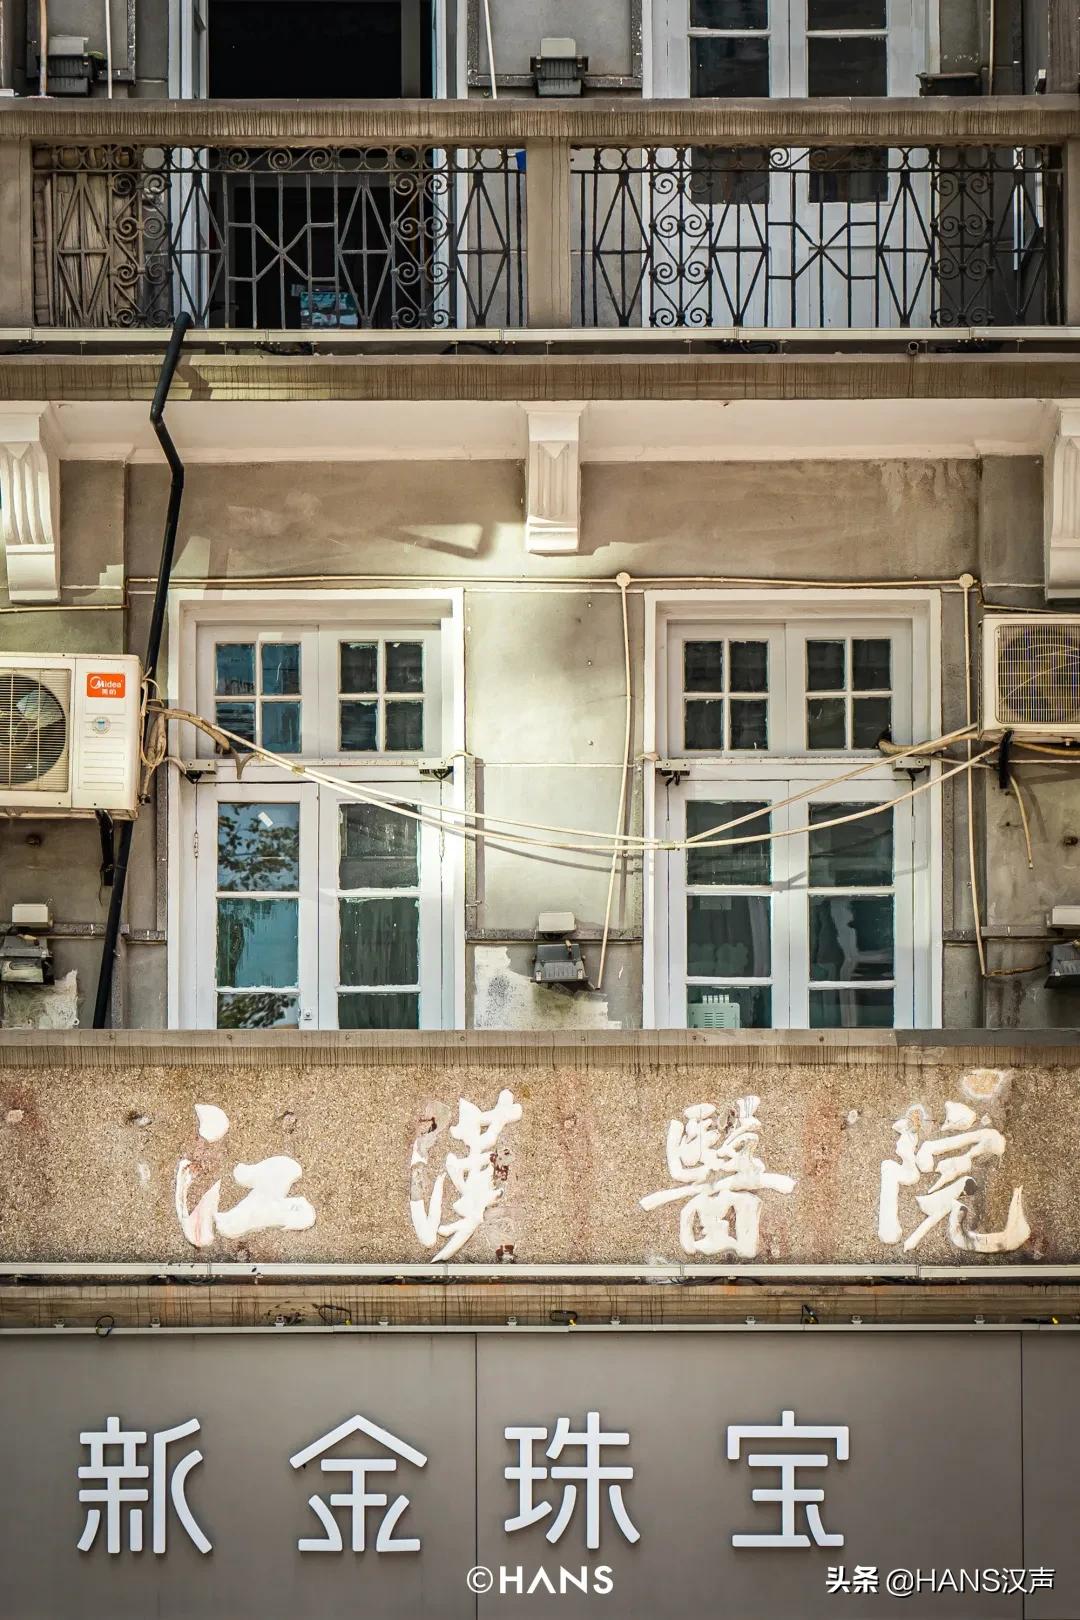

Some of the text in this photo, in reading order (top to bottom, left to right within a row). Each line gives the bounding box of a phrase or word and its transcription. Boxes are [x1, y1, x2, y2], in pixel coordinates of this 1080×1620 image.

[92, 678, 122, 689] Midea
[76, 1410, 850, 1554] 新金珠宝
